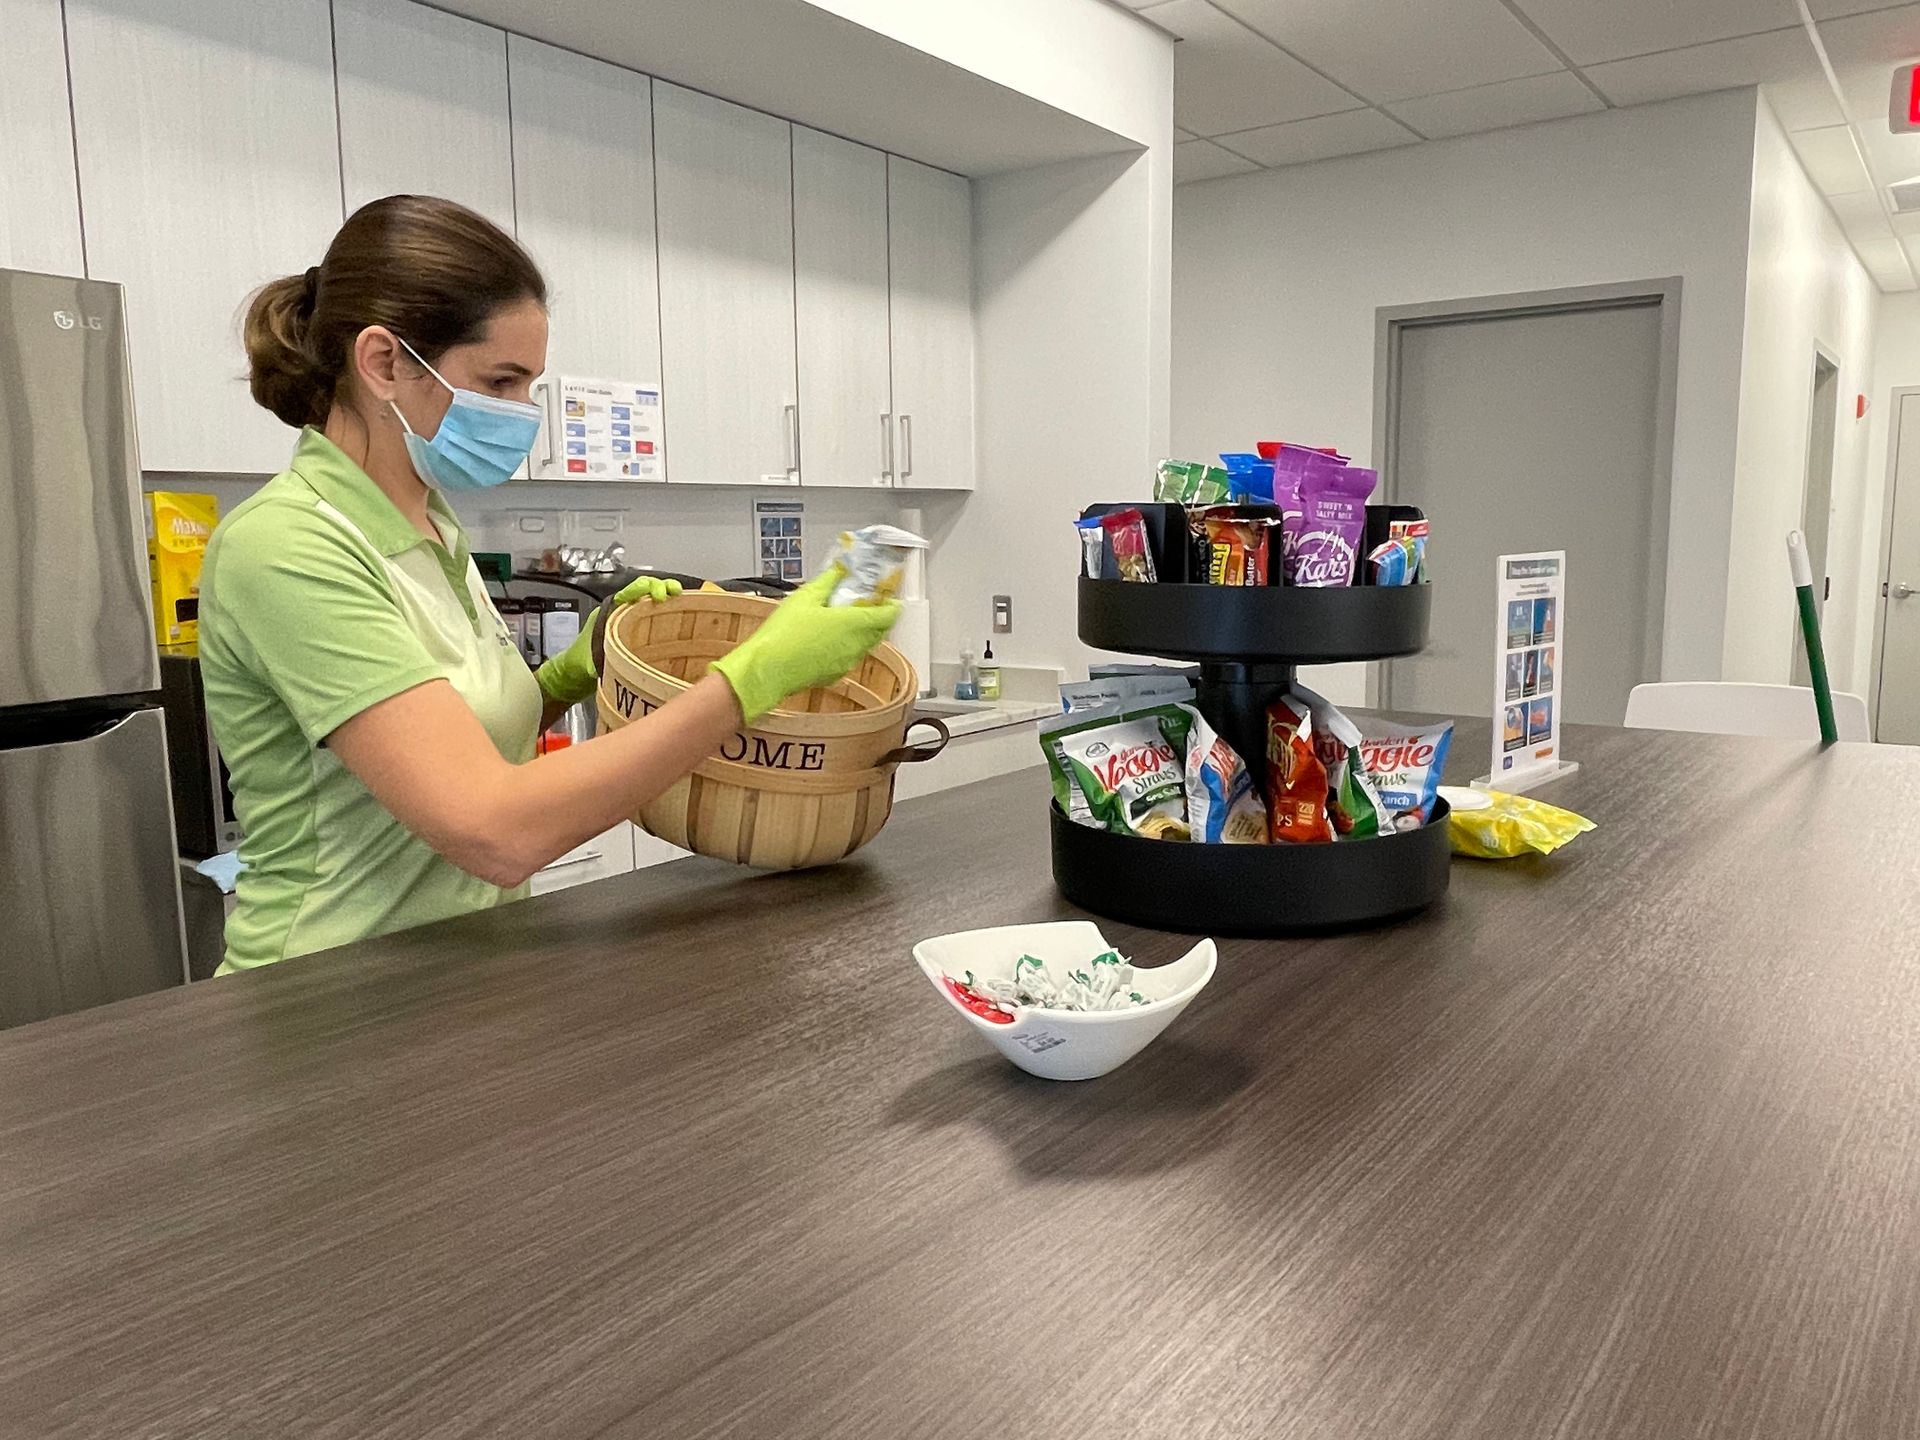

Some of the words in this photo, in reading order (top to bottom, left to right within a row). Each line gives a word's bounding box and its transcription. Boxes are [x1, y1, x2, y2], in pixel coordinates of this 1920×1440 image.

[79, 314, 102, 331] LG
[1362, 735, 1435, 773] ggie
[1132, 766, 1177, 795] Straws
